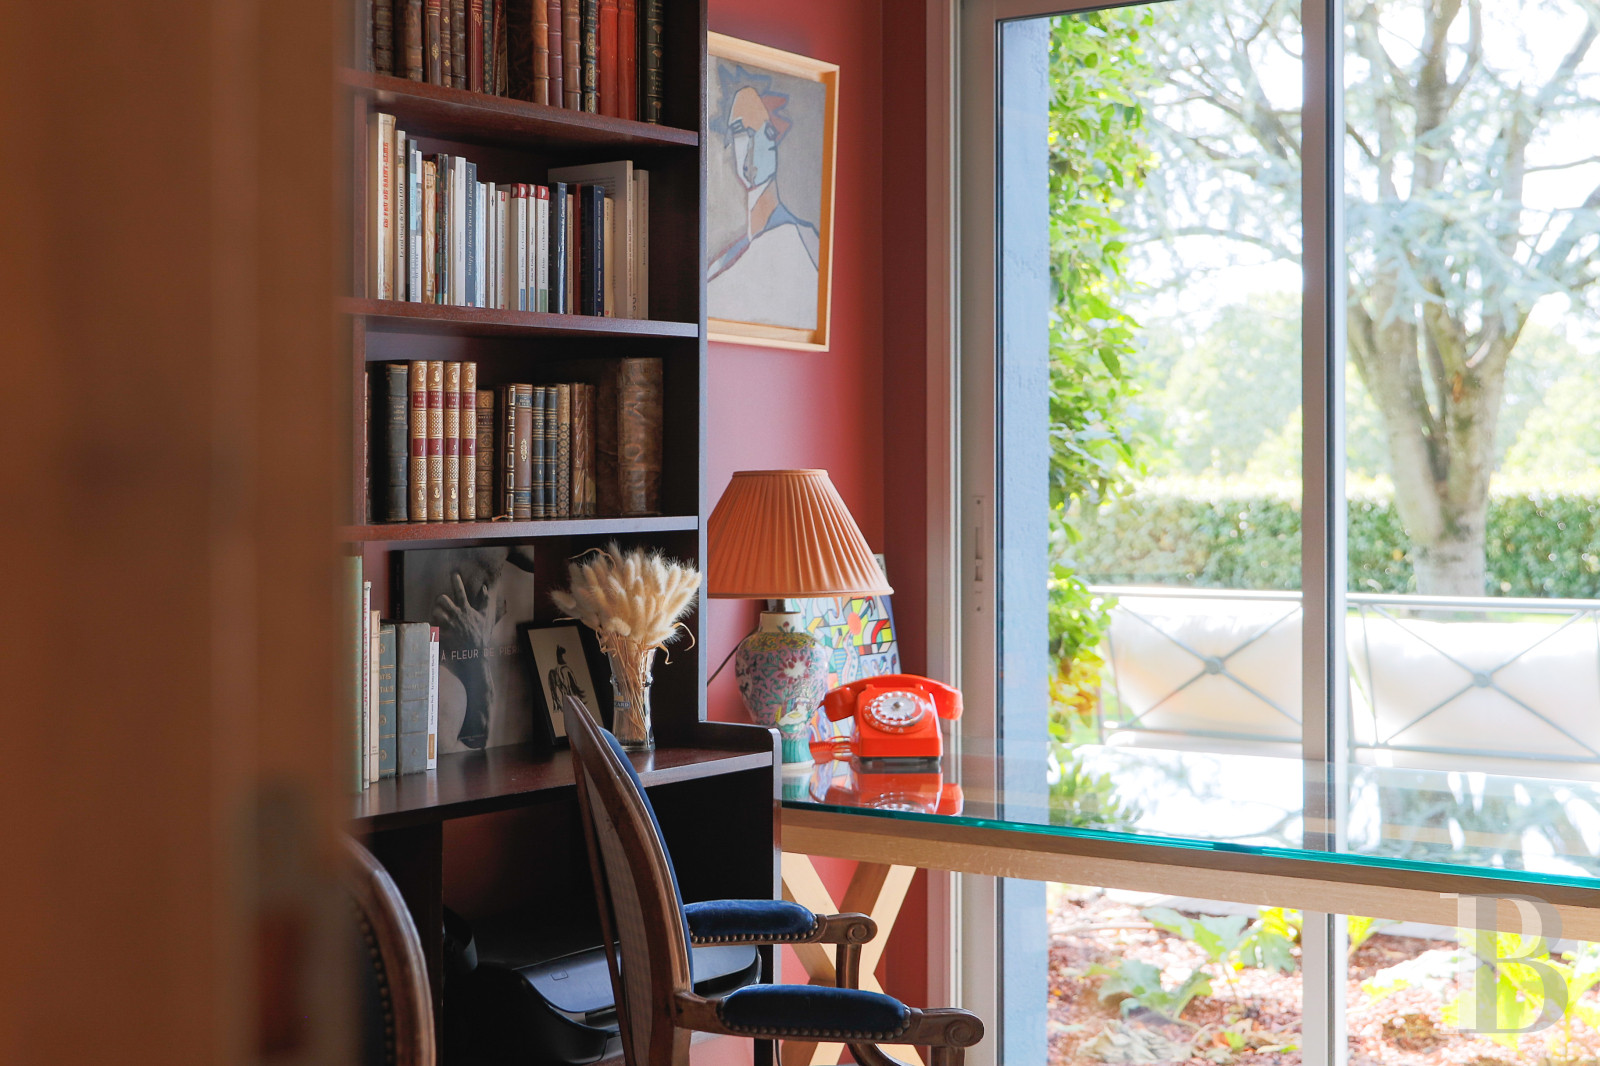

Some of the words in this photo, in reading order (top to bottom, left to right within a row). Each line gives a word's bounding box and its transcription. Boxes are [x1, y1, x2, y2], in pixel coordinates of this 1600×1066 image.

[383, 189, 389, 200] DE
[383, 219, 389, 228] LE
[451, 649, 478, 660] FLEUR
[483, 648, 495, 657] DE
